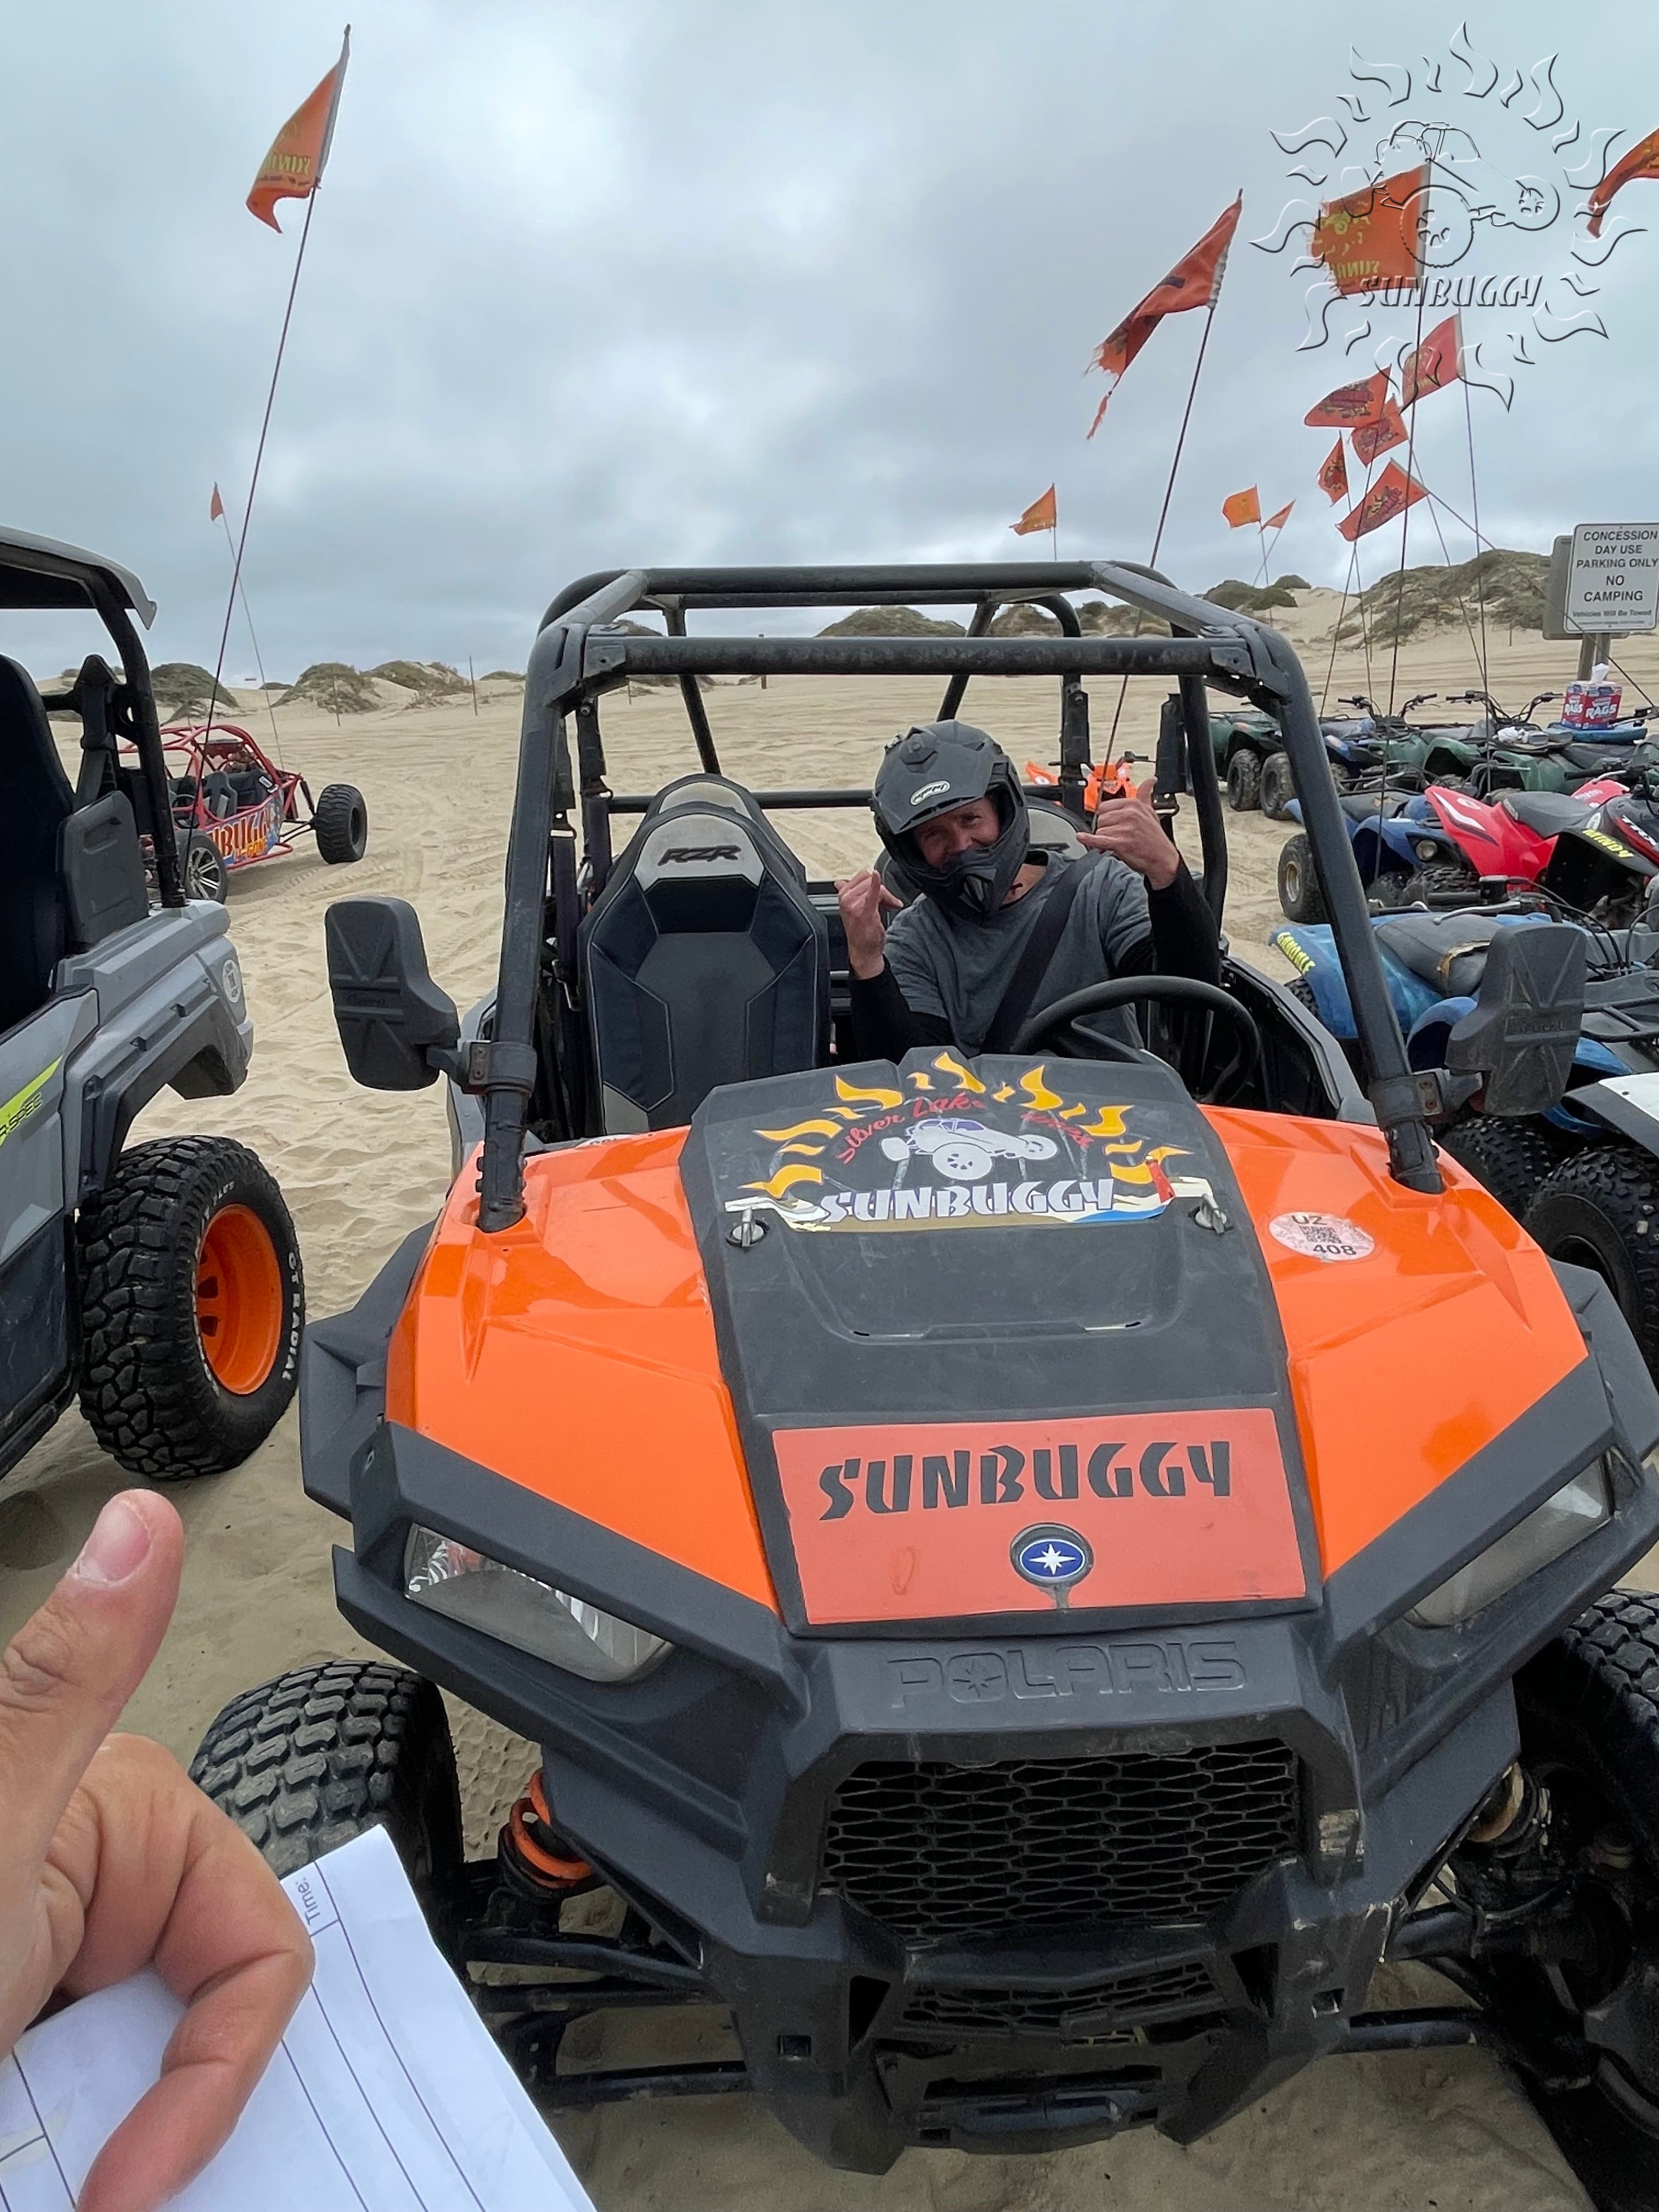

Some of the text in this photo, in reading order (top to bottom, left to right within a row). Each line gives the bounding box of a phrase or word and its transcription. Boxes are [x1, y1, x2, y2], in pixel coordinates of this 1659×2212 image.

[1583, 530, 1658, 541] CONCESSION
[1595, 544, 1643, 554] DAY USE
[1577, 557, 1658, 568] PARKING ONLY
[1606, 574, 1625, 586] NO
[1584, 590, 1644, 602] CAMPING
[1585, 703, 1617, 720] RAGS
[1582, 829, 1634, 858] MINDY
[658, 845, 741, 867] RZR
[822, 1176, 1114, 1223] SUNBUGGY
[1313, 1244, 1357, 1255] 408
[281, 1293, 301, 1381] RADIAL
[818, 1440, 1231, 1521] SUNBUGGY
[887, 1640, 1248, 1709] POLARIS
[295, 1877, 321, 1926] Time:
